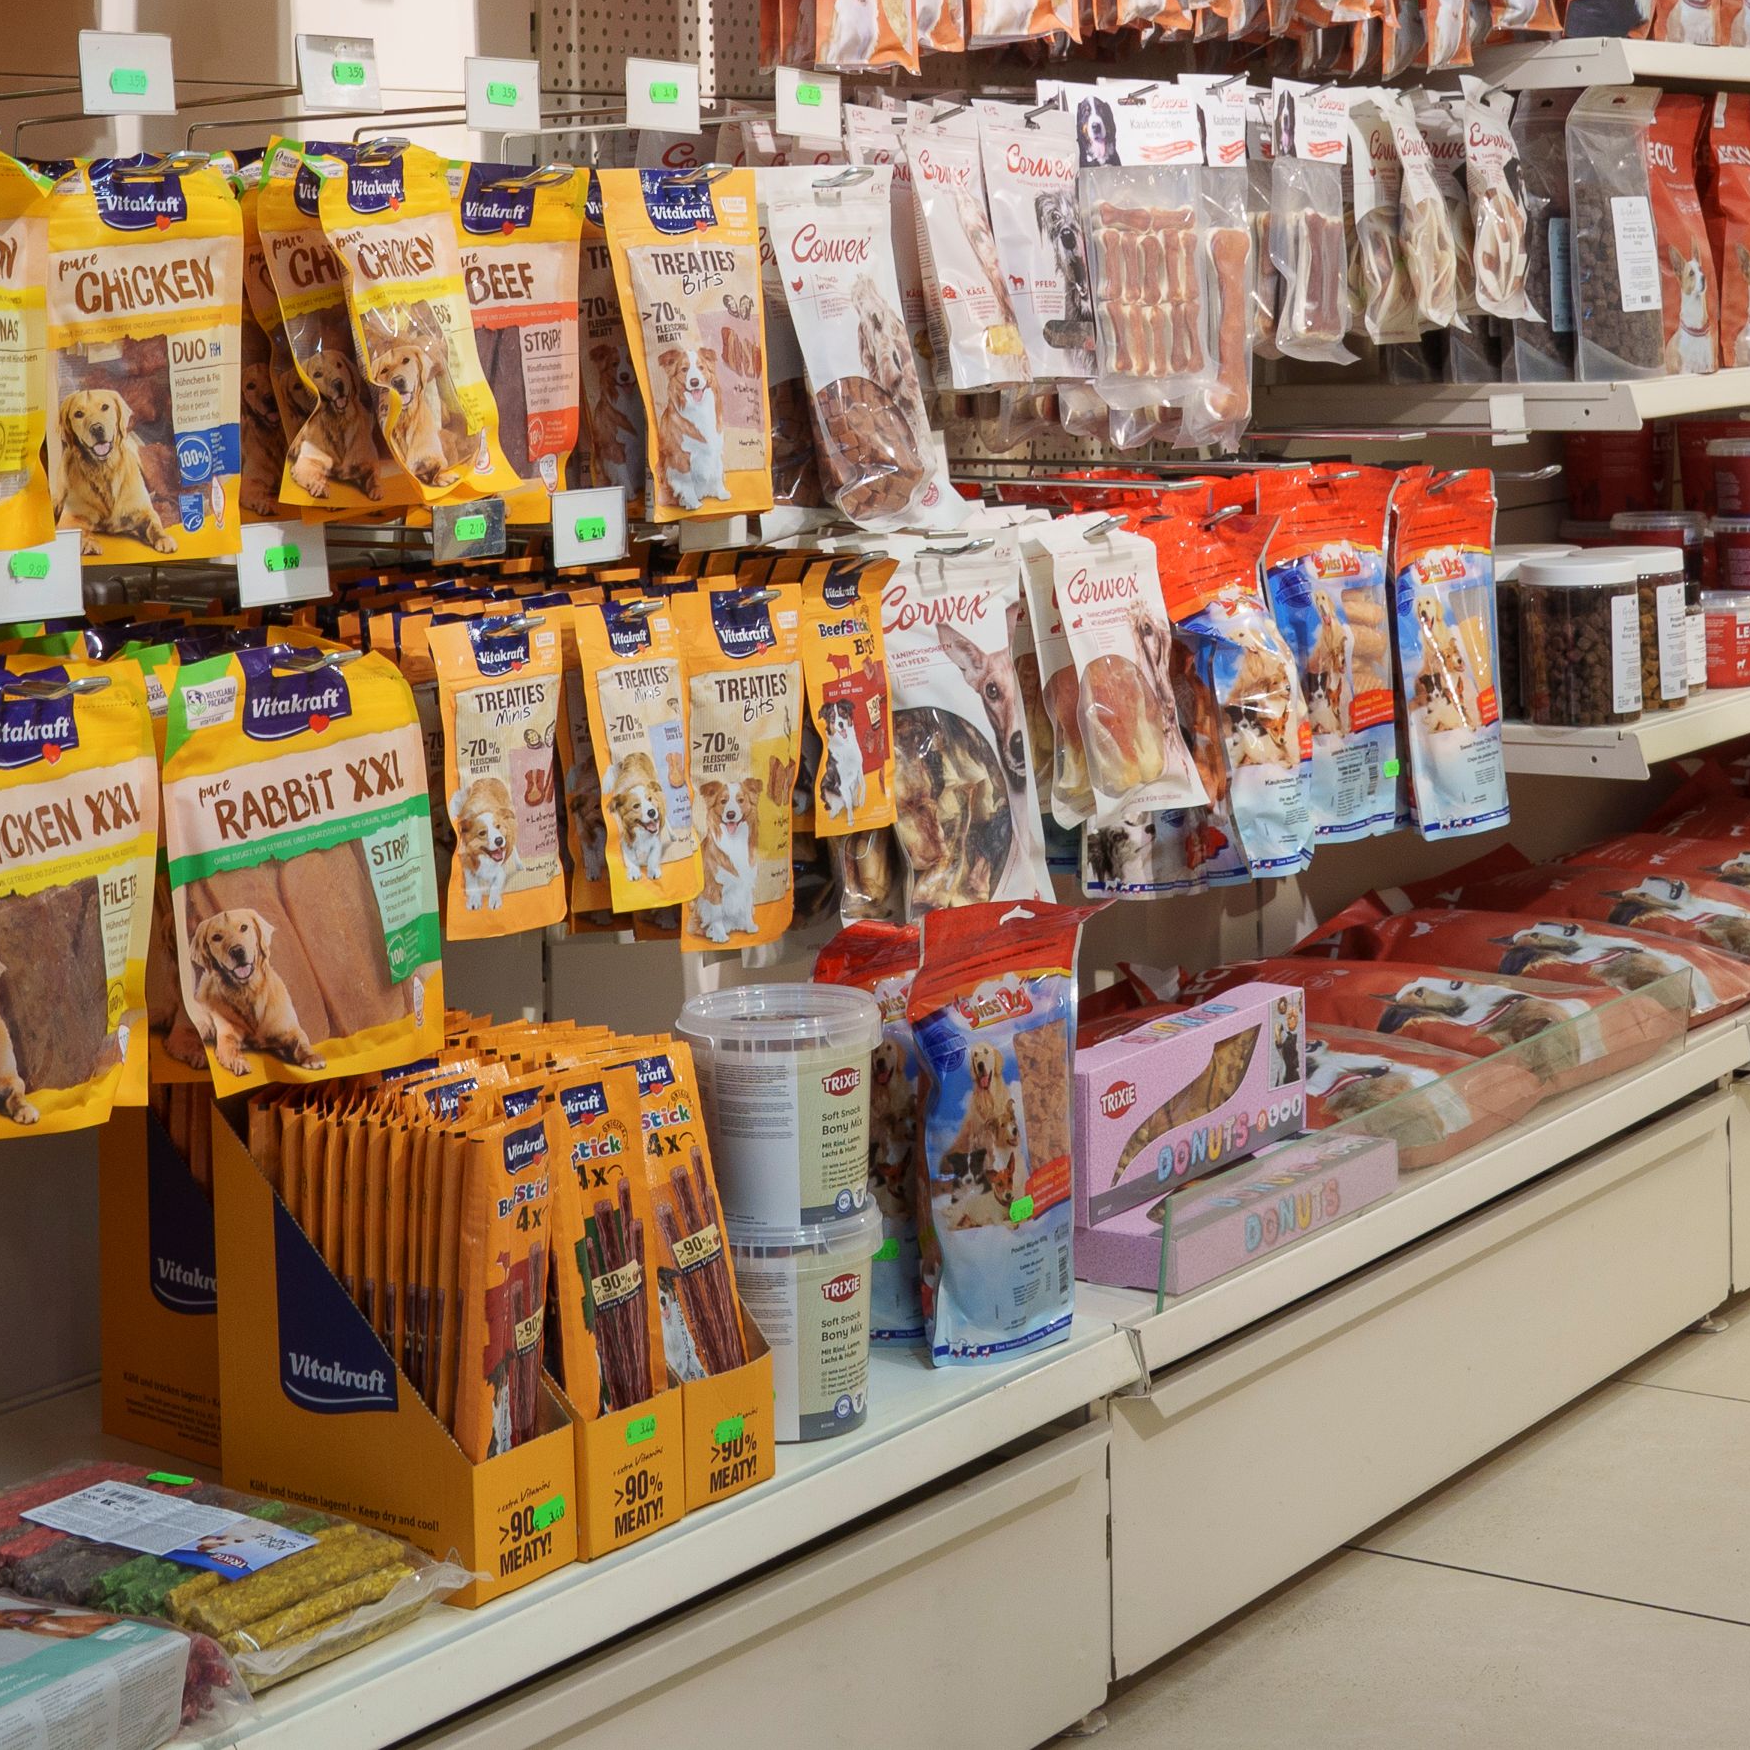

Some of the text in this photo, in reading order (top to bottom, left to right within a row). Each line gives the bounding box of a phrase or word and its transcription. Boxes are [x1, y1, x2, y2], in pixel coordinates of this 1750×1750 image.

[348, 66, 364, 78] 3.50
[502, 87, 516, 100] 3.50
[1130, 117, 1183, 133] Kauknochen
[1302, 117, 1338, 130] Kauknochen
[105, 194, 181, 213] Vitakraft
[465, 200, 529, 220] Vitakraft
[791, 223, 872, 265] Corwex
[58, 253, 99, 282] pure
[650, 249, 735, 276] TREATIES
[464, 261, 534, 303] BEEF
[681, 273, 724, 296] Bits
[965, 284, 987, 296] KÄSE
[1035, 279, 1057, 289] PFERD
[657, 332, 682, 343] MEATY
[172, 338, 206, 364] DUO
[179, 446, 211, 468] 100%
[283, 556, 300, 568] 9.90
[1066, 569, 1139, 605] Corwex
[477, 646, 526, 666] Vitakraft
[614, 666, 669, 691] TREATIES
[714, 673, 788, 703] TREATIES
[252, 687, 343, 719] Vitakraft
[475, 684, 545, 714] TREATIES
[742, 698, 775, 724] Bits
[494, 706, 531, 728] Minis
[345, 749, 404, 803] XXL
[470, 764, 491, 775] MEATY
[198, 778, 232, 808] pure
[822, 1105, 861, 1123] Soft Snack
[822, 1117, 863, 1137] Bony Mix
[647, 1131, 682, 1158] 4x
[1157, 1110, 1250, 1183] DONUTS
[1243, 1180, 1341, 1252] DONUTS
[289, 1352, 386, 1393] Vitakraft
[710, 1455, 757, 1494] MEATY!
[249, 1480, 439, 1532] Kühl und trocken lagern! Keep dry and cool!
[615, 1496, 664, 1538] MEATY!
[500, 1531, 552, 1578] MEATY!
